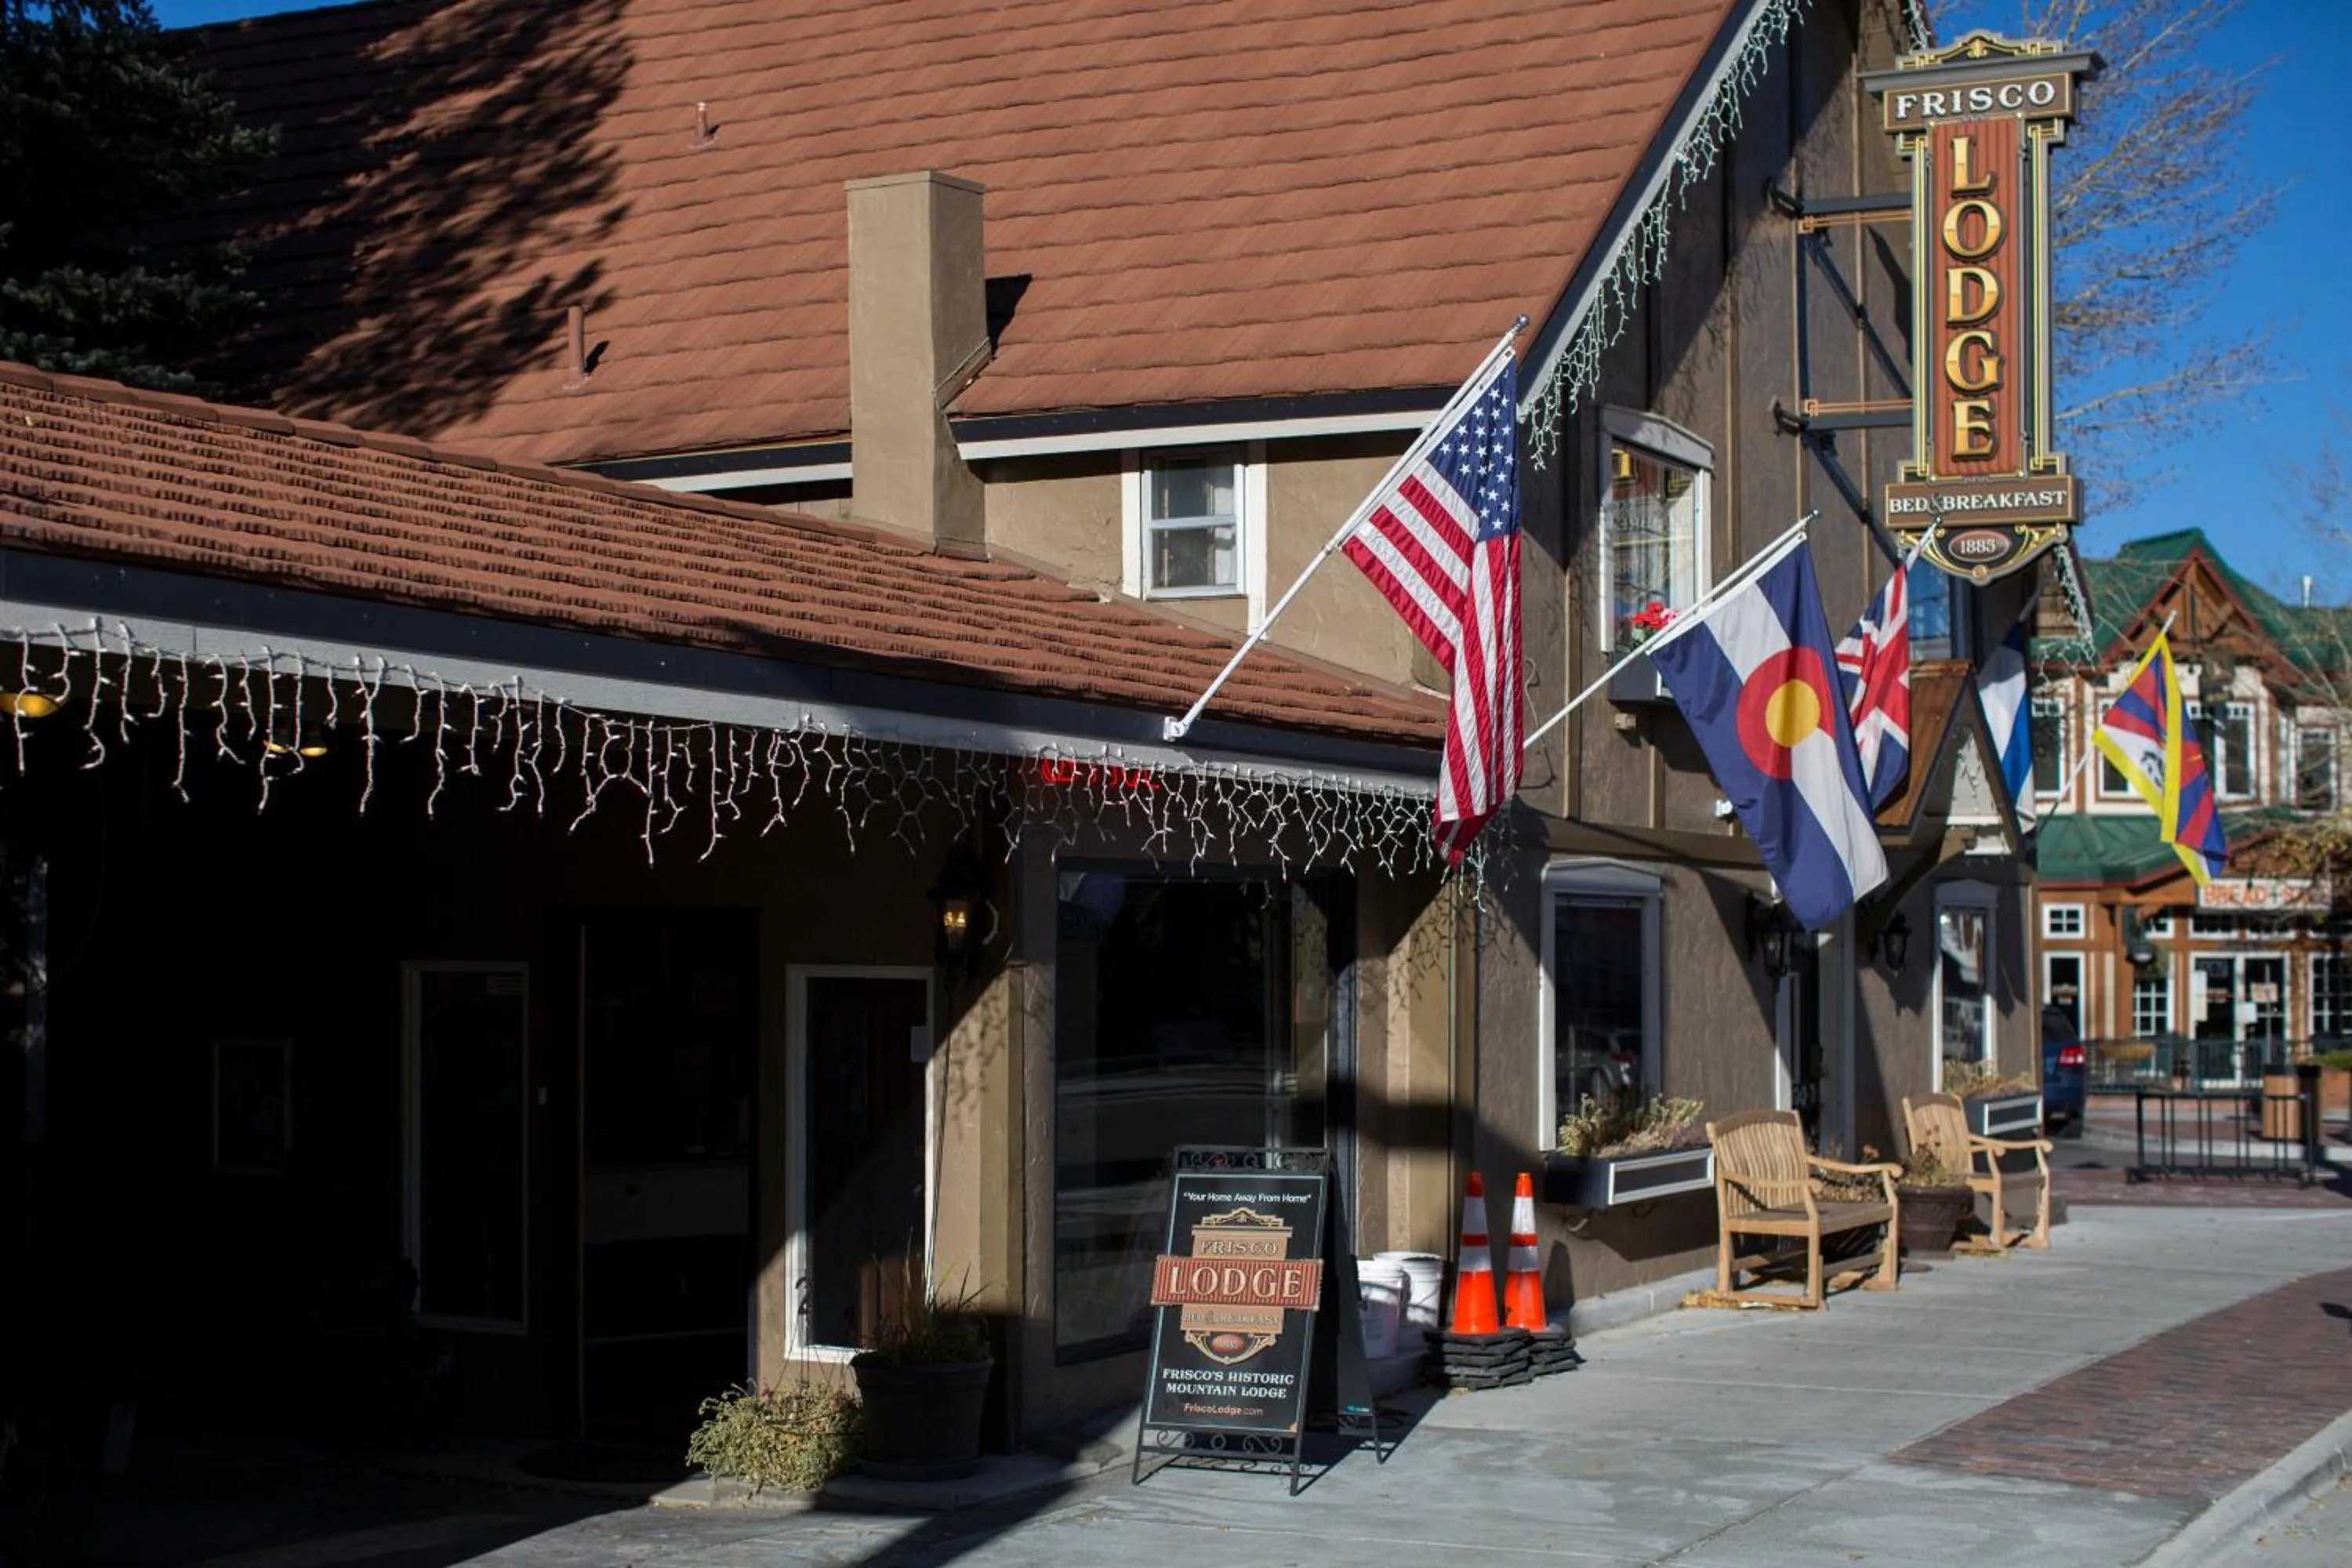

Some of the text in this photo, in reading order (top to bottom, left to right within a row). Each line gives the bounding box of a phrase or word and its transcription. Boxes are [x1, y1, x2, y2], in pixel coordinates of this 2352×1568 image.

[1896, 81, 2056, 118] FRISCO
[1943, 136, 2004, 461] LODGE
[1889, 496, 1928, 514] BED
[1943, 490, 2067, 510] BREAKFAST
[1207, 1192, 1232, 1202] Home
[1233, 1192, 1256, 1203] Away
[1258, 1193, 1280, 1203] From
[1201, 1240, 1279, 1255] FRISCO
[1169, 1266, 1302, 1298] LODGE
[1162, 1368, 1295, 1385] FRISCO'S HISTORIC
[1166, 1383, 1287, 1399] MOUNTAIN LODGE
[1184, 1403, 1264, 1417] FriscoLodge.com
